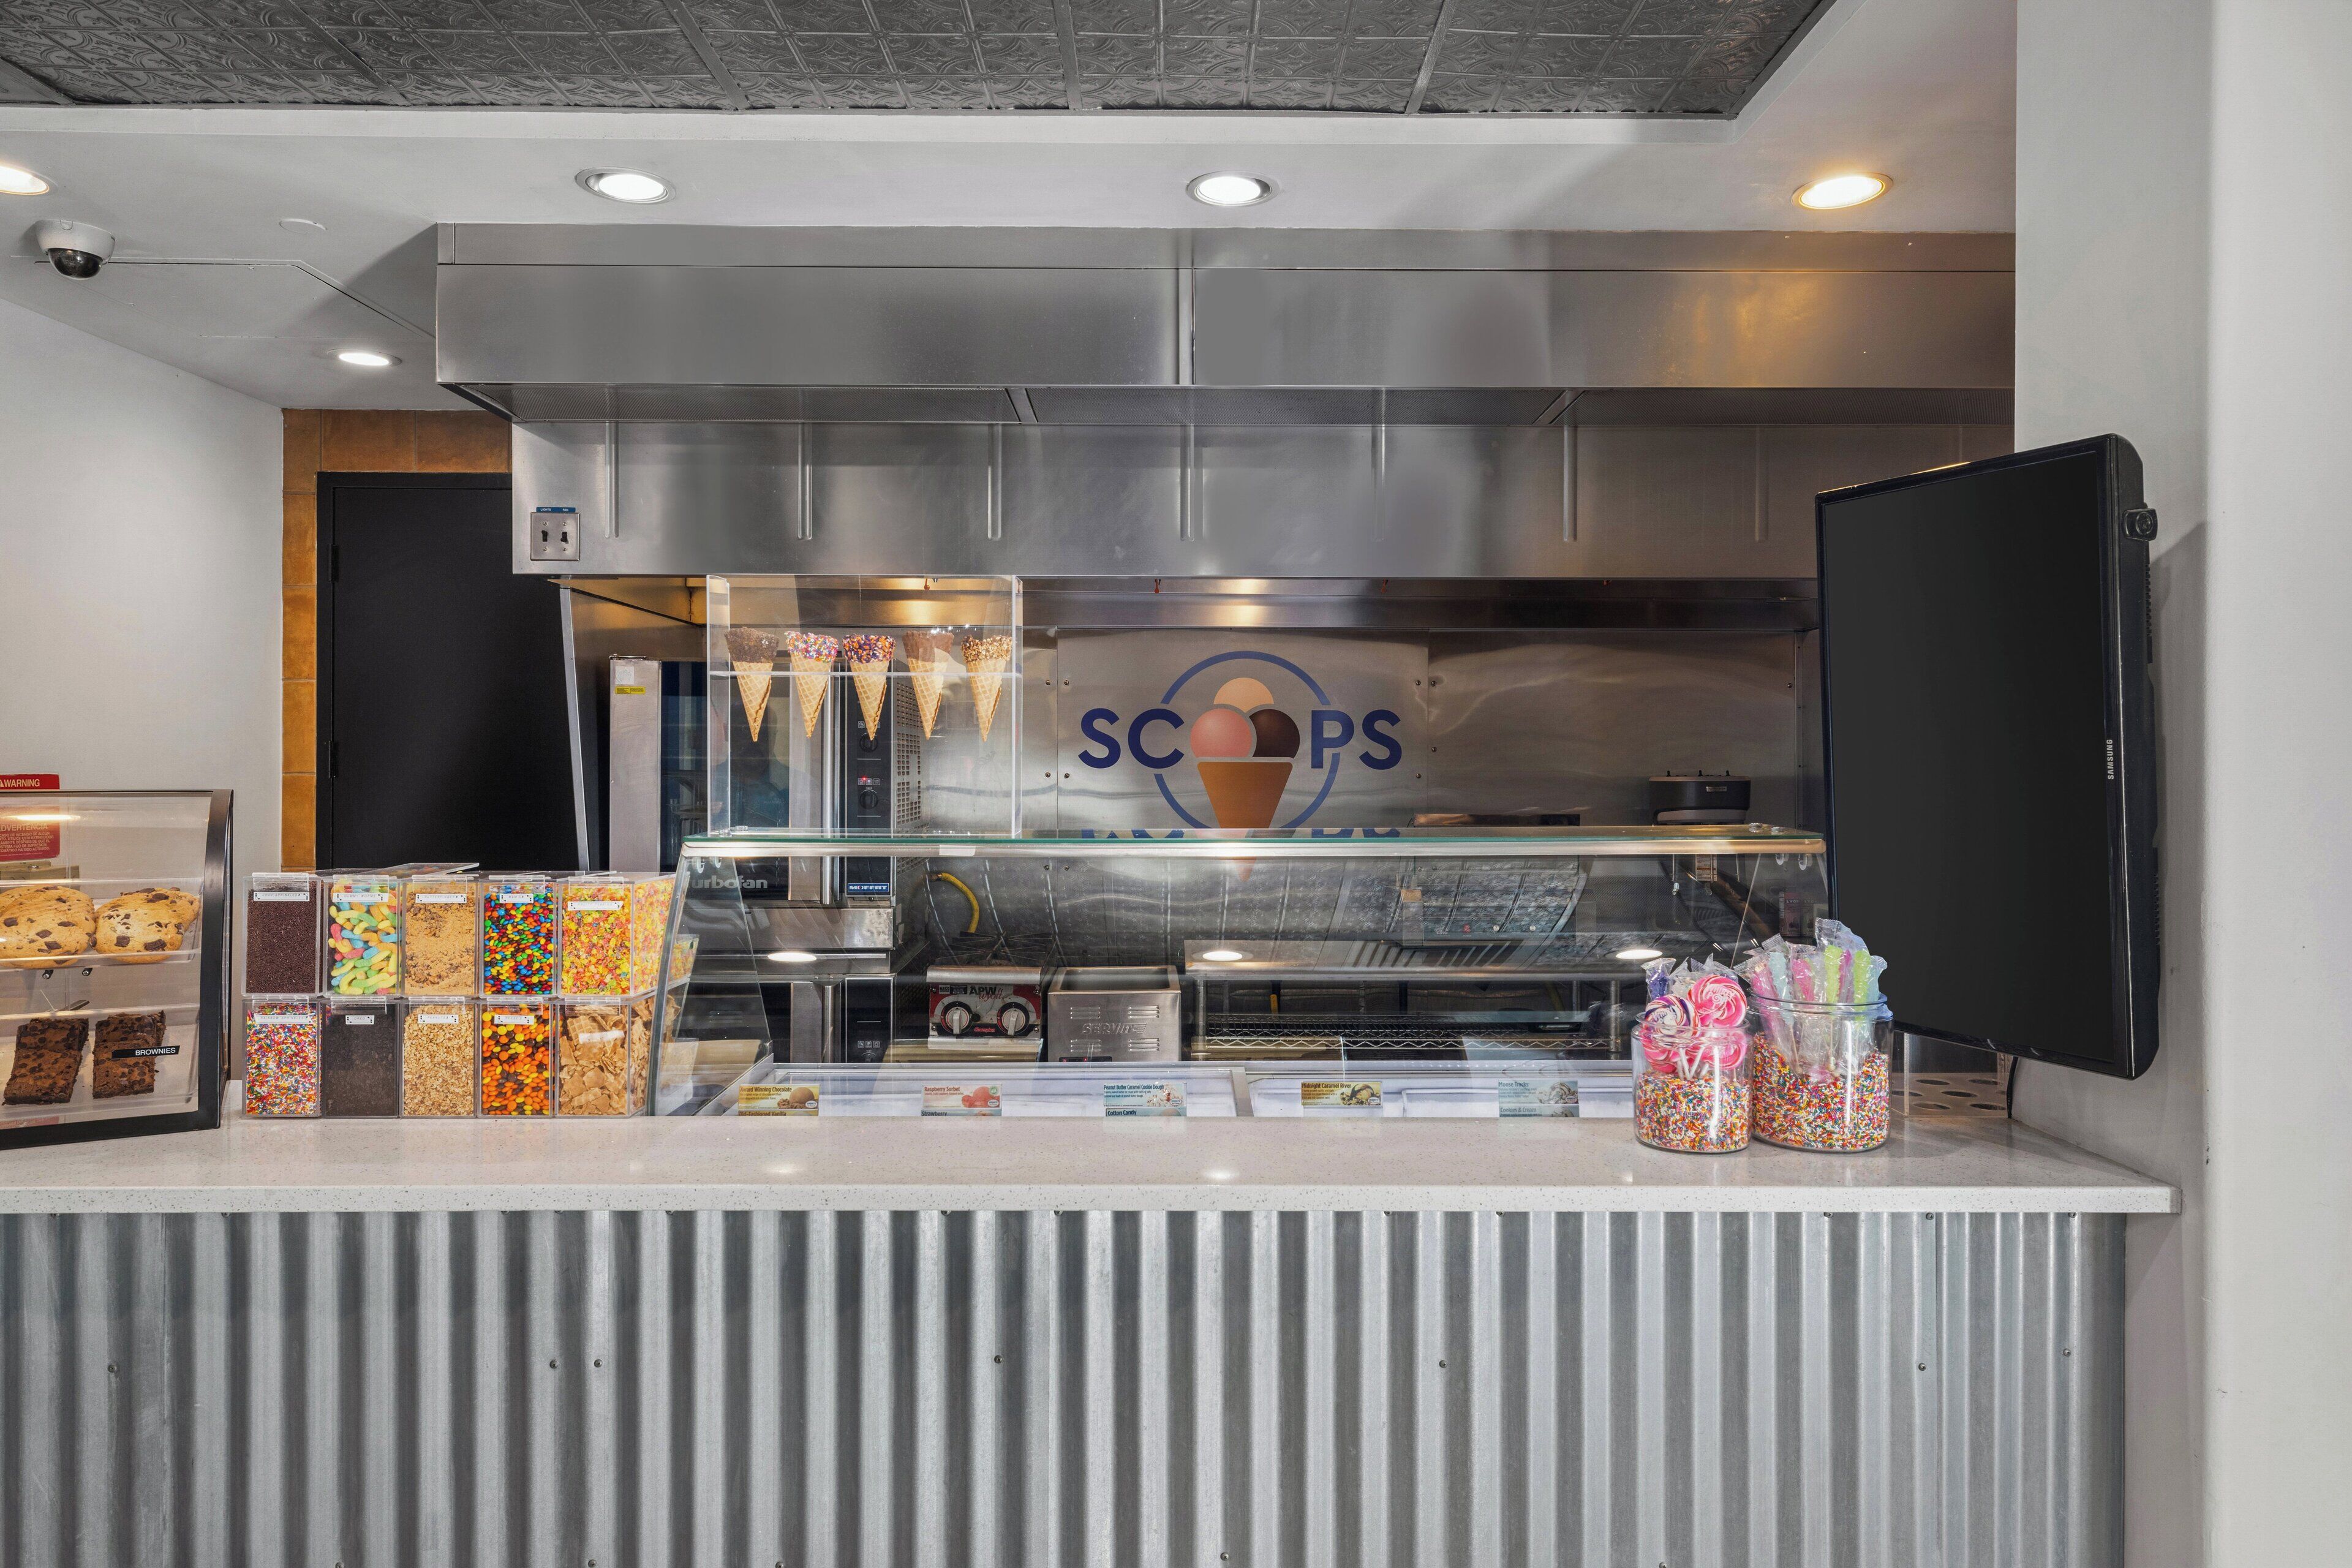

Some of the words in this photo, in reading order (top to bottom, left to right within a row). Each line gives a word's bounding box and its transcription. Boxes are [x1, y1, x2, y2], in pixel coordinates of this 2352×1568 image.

[2106, 739, 2114, 780] SAMSUNG
[4, 778, 40, 788] WARNING
[0, 823, 48, 832] DVERTENCIA
[687, 875, 768, 889] urbofan
[969, 985, 997, 995] APW
[135, 1047, 176, 1056] BROWNIES
